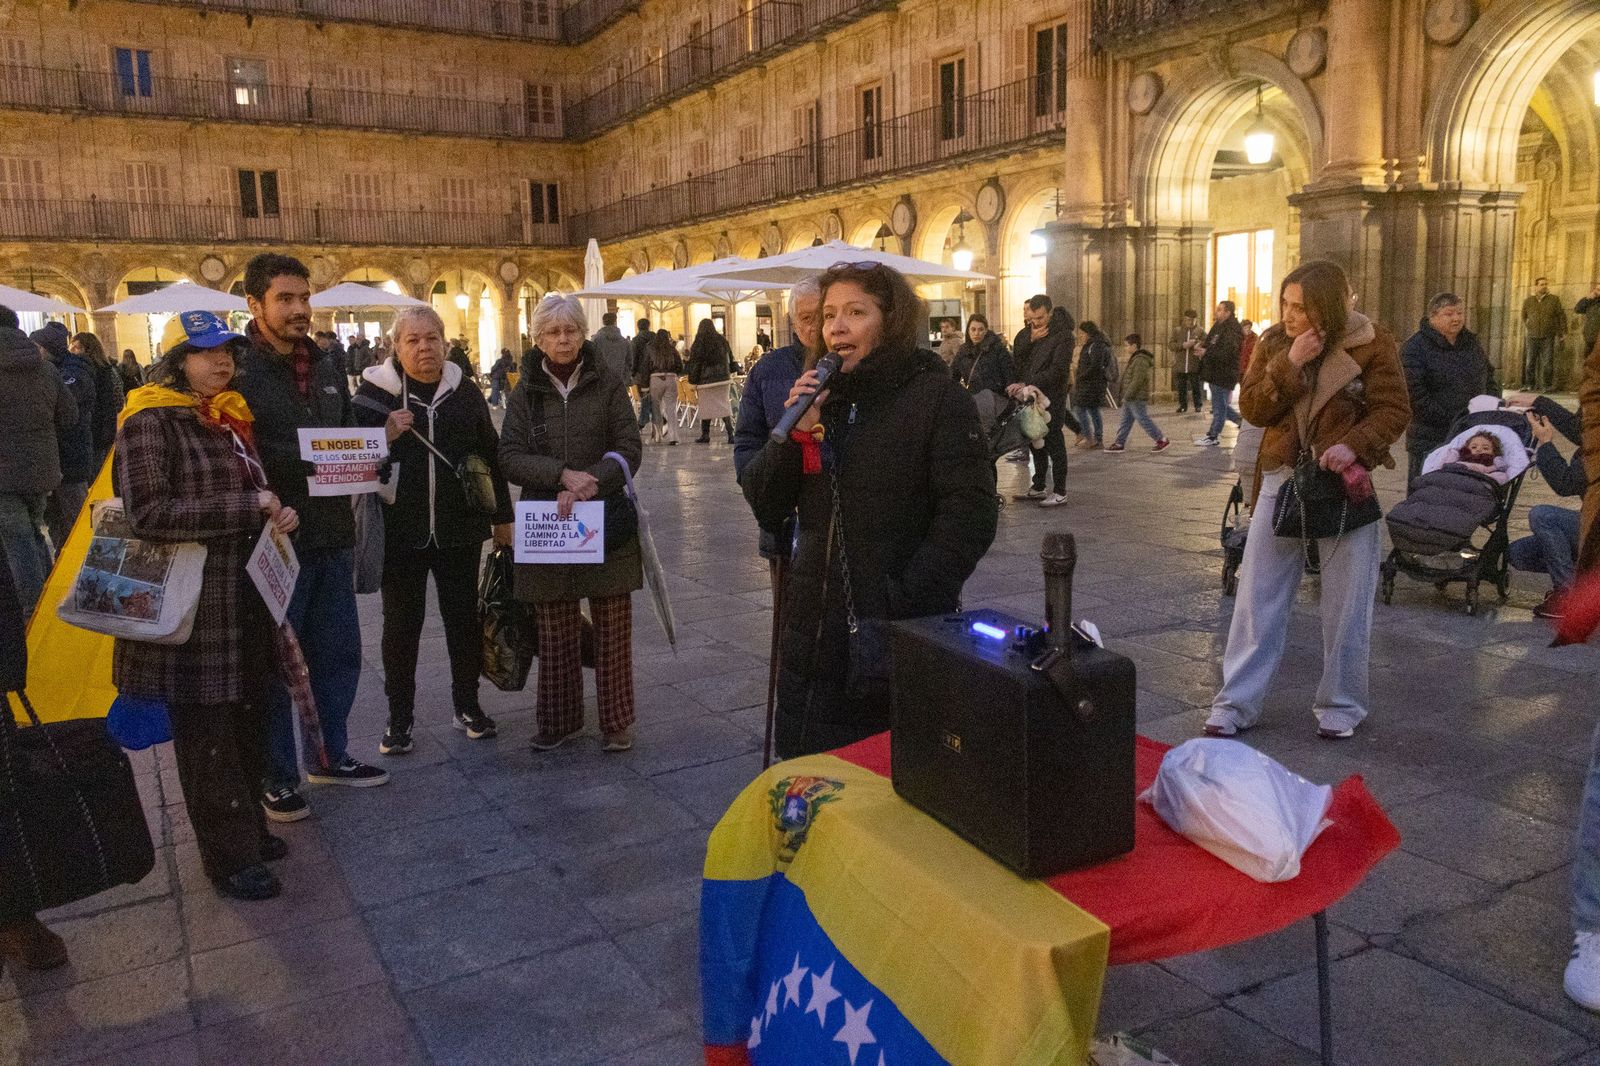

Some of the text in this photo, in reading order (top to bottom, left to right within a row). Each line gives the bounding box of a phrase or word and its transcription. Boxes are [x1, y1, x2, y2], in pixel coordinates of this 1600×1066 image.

[311, 440, 379, 450] EL NOBEL ES
[341, 453, 356, 461] QUE
[315, 463, 377, 473] NJUSTAMENT
[315, 474, 363, 483] DETENIDOS
[525, 512, 579, 522] EL NOBEL
[525, 531, 558, 539] CAMINO
[569, 531, 579, 539] LA
